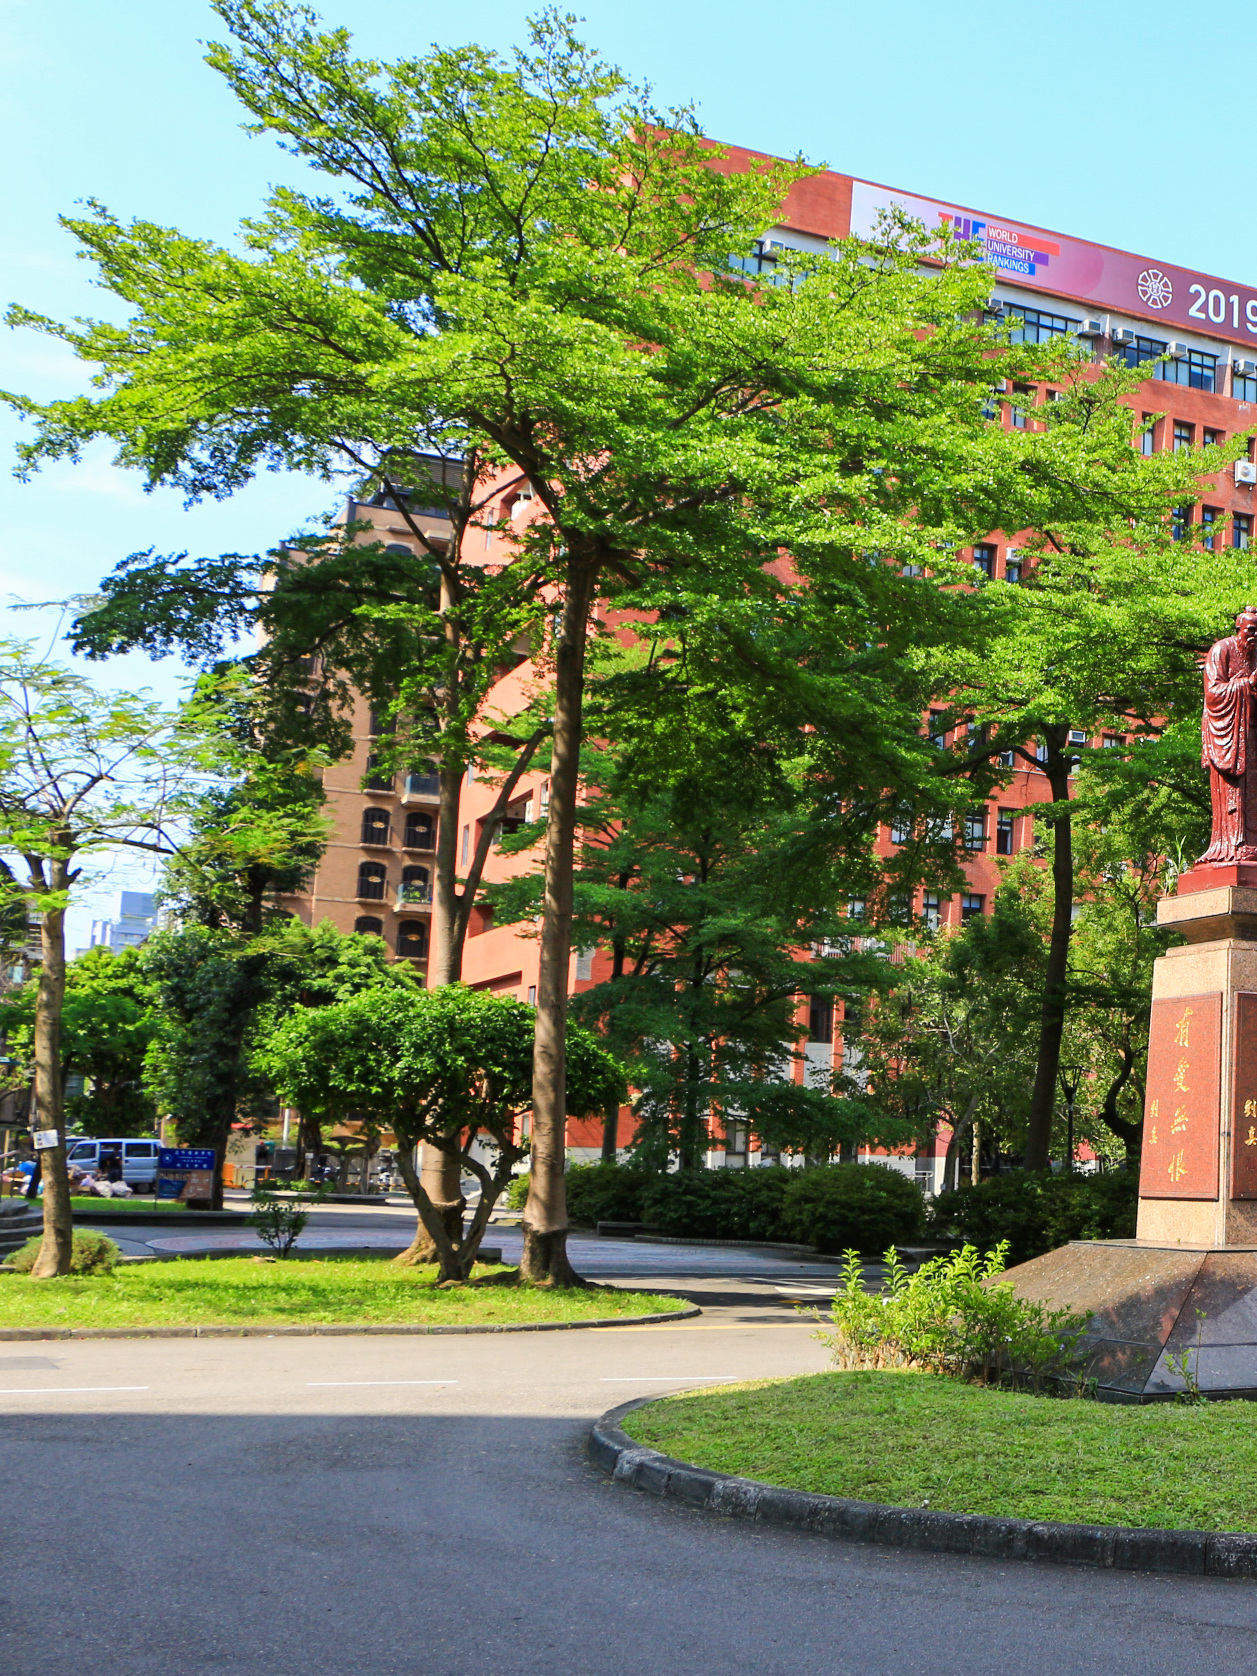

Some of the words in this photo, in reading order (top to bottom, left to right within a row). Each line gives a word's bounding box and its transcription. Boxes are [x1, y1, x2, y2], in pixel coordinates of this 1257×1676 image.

[988, 226, 1018, 244] WORLD
[987, 239, 1035, 262] UNIVERSITY
[987, 254, 1030, 274] RANKINGS
